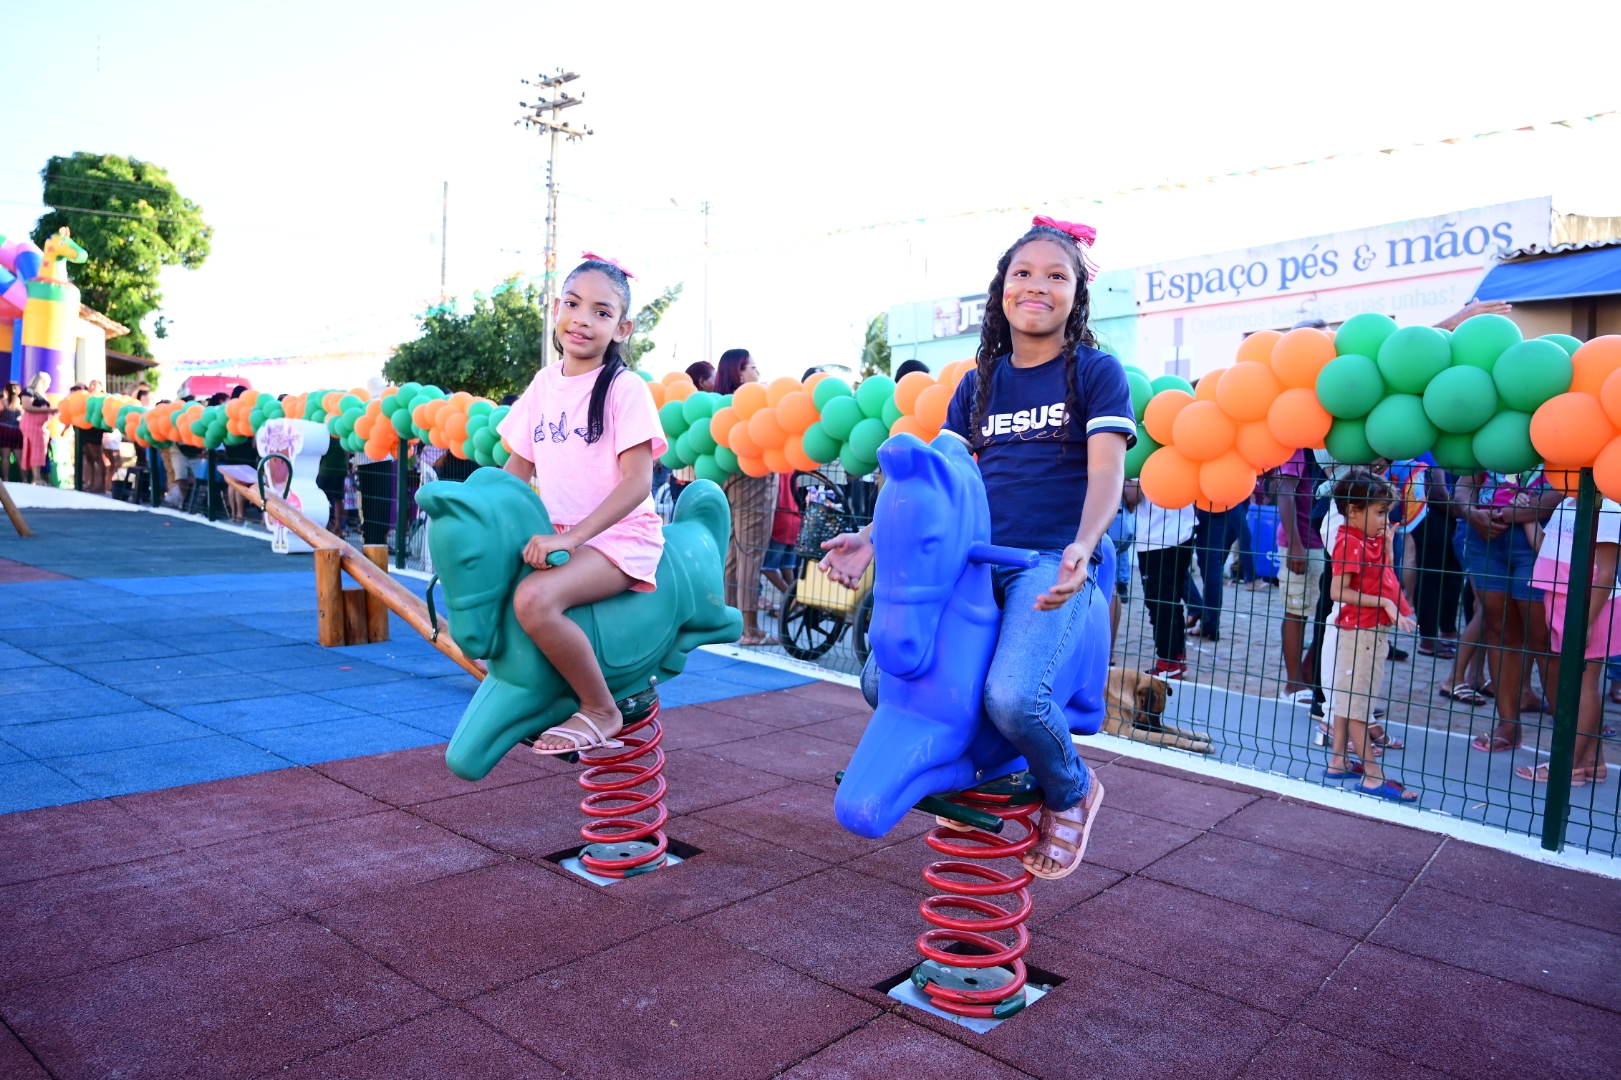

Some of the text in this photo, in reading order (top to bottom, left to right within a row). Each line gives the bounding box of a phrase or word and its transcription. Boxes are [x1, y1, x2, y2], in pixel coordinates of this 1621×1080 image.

[1145, 221, 1513, 303] Espaço pés & mãos
[958, 298, 988, 332] JE
[1191, 311, 1267, 335] Cuidamos
[1310, 302, 1339, 319] das
[1343, 296, 1386, 315] suas
[1391, 285, 1456, 311] unhas!
[981, 402, 1070, 437] JESUS
